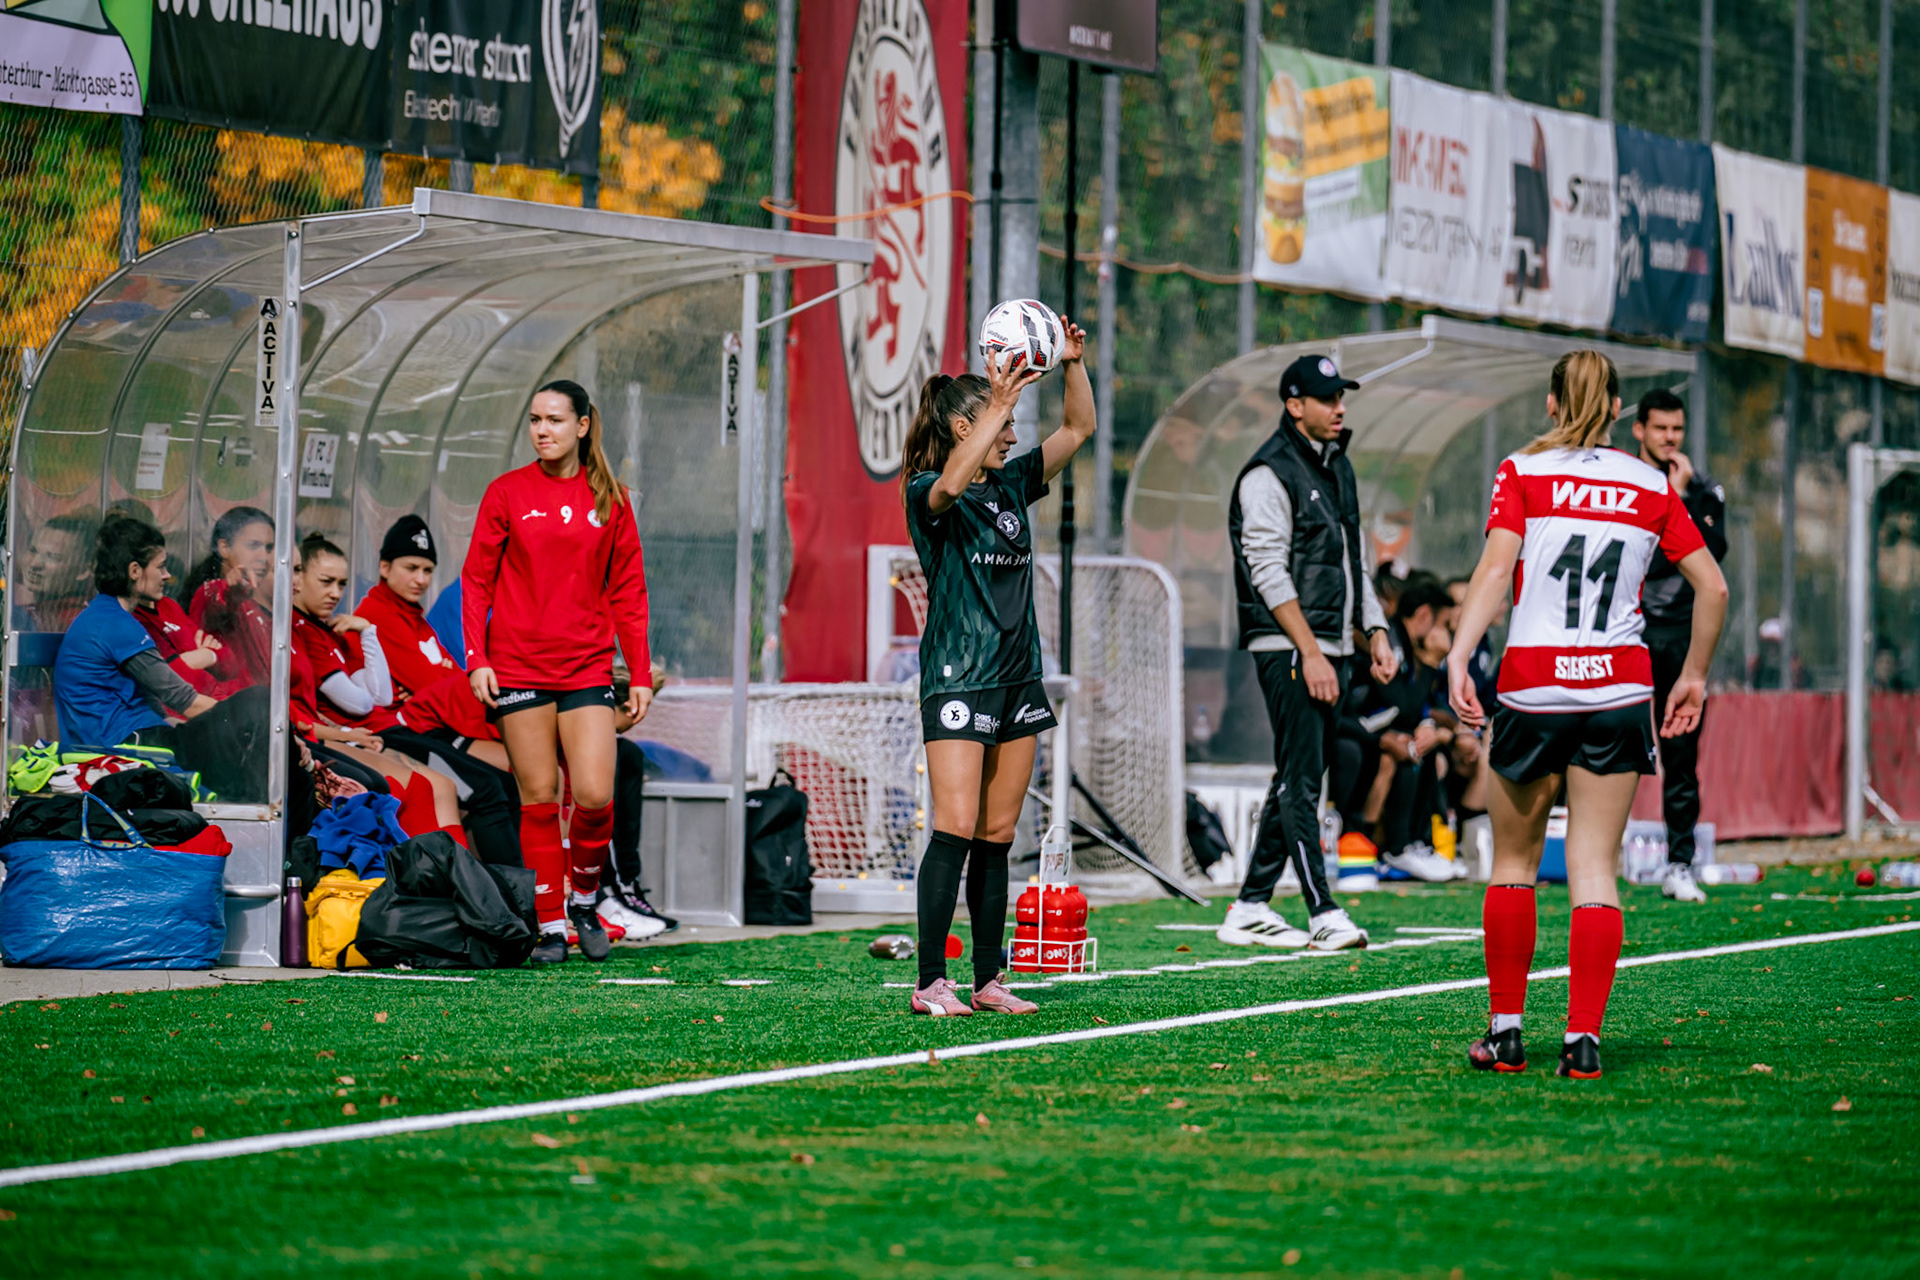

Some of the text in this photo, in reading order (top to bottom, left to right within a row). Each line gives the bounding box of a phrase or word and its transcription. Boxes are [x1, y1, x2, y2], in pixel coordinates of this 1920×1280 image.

[52, 65, 117, 102] Marktgasse
[119, 72, 135, 97] 55
[261, 321, 277, 409] ACTIVA
[560, 505, 573, 525] 9
[1552, 480, 1638, 515] WOZ
[1547, 533, 1626, 633] 11
